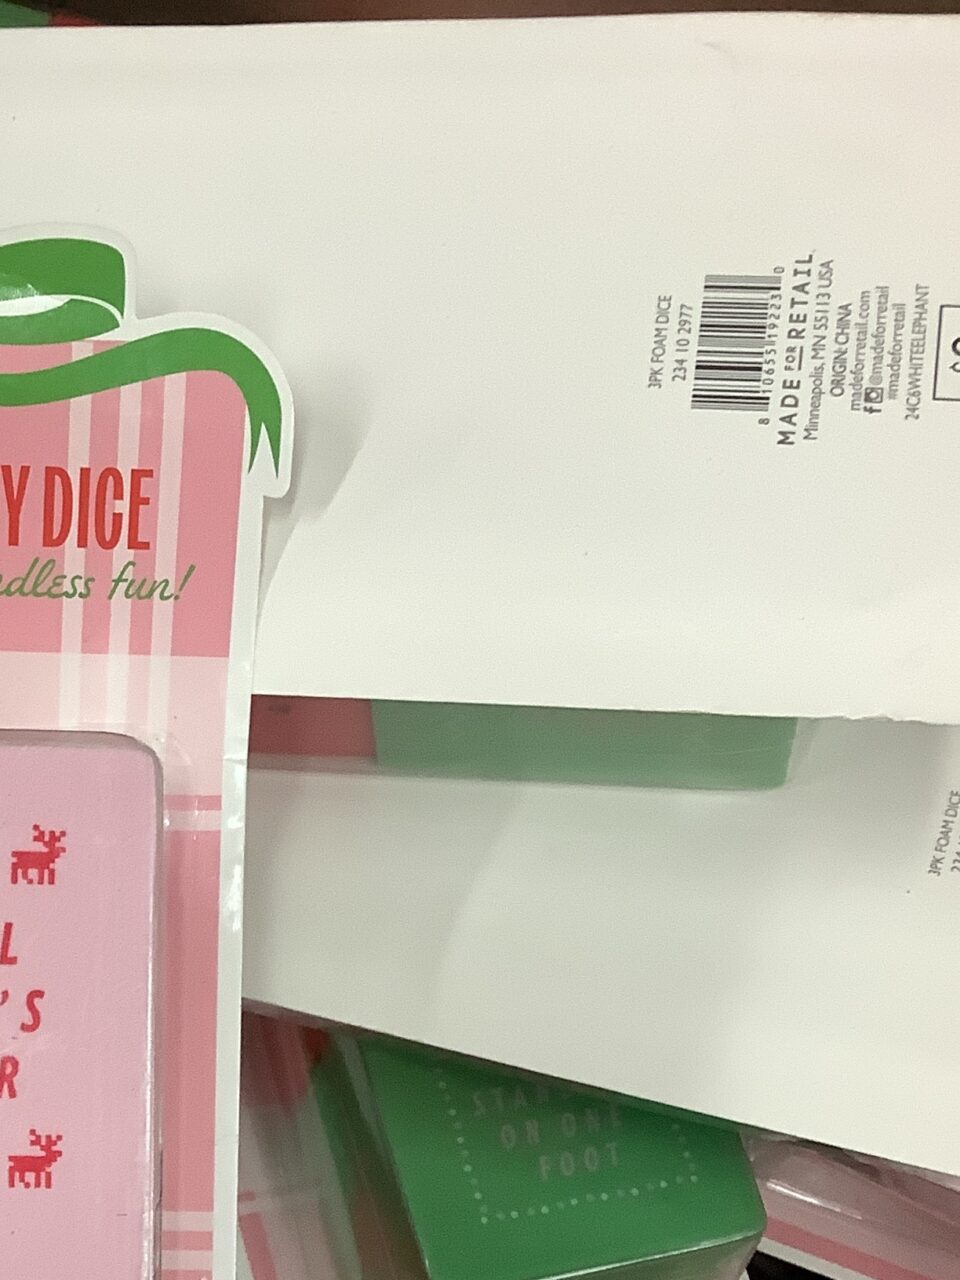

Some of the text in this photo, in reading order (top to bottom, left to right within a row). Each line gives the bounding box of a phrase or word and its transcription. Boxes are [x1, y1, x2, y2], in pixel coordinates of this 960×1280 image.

[648, 294, 673, 390] 3PK FOAM DICE
[672, 303, 694, 382] 234 10 2977
[777, 252, 814, 446] MADE FOR RETAIL
[803, 259, 835, 440] Minneapolis, MN 55113 USA
[830, 303, 853, 397] ORIGIN: CHINA
[851, 290, 871, 412] madeforretail.com
[42, 465, 154, 551] DICE
[108, 563, 196, 603] fun!
[538, 1140, 620, 1182] FOOT
